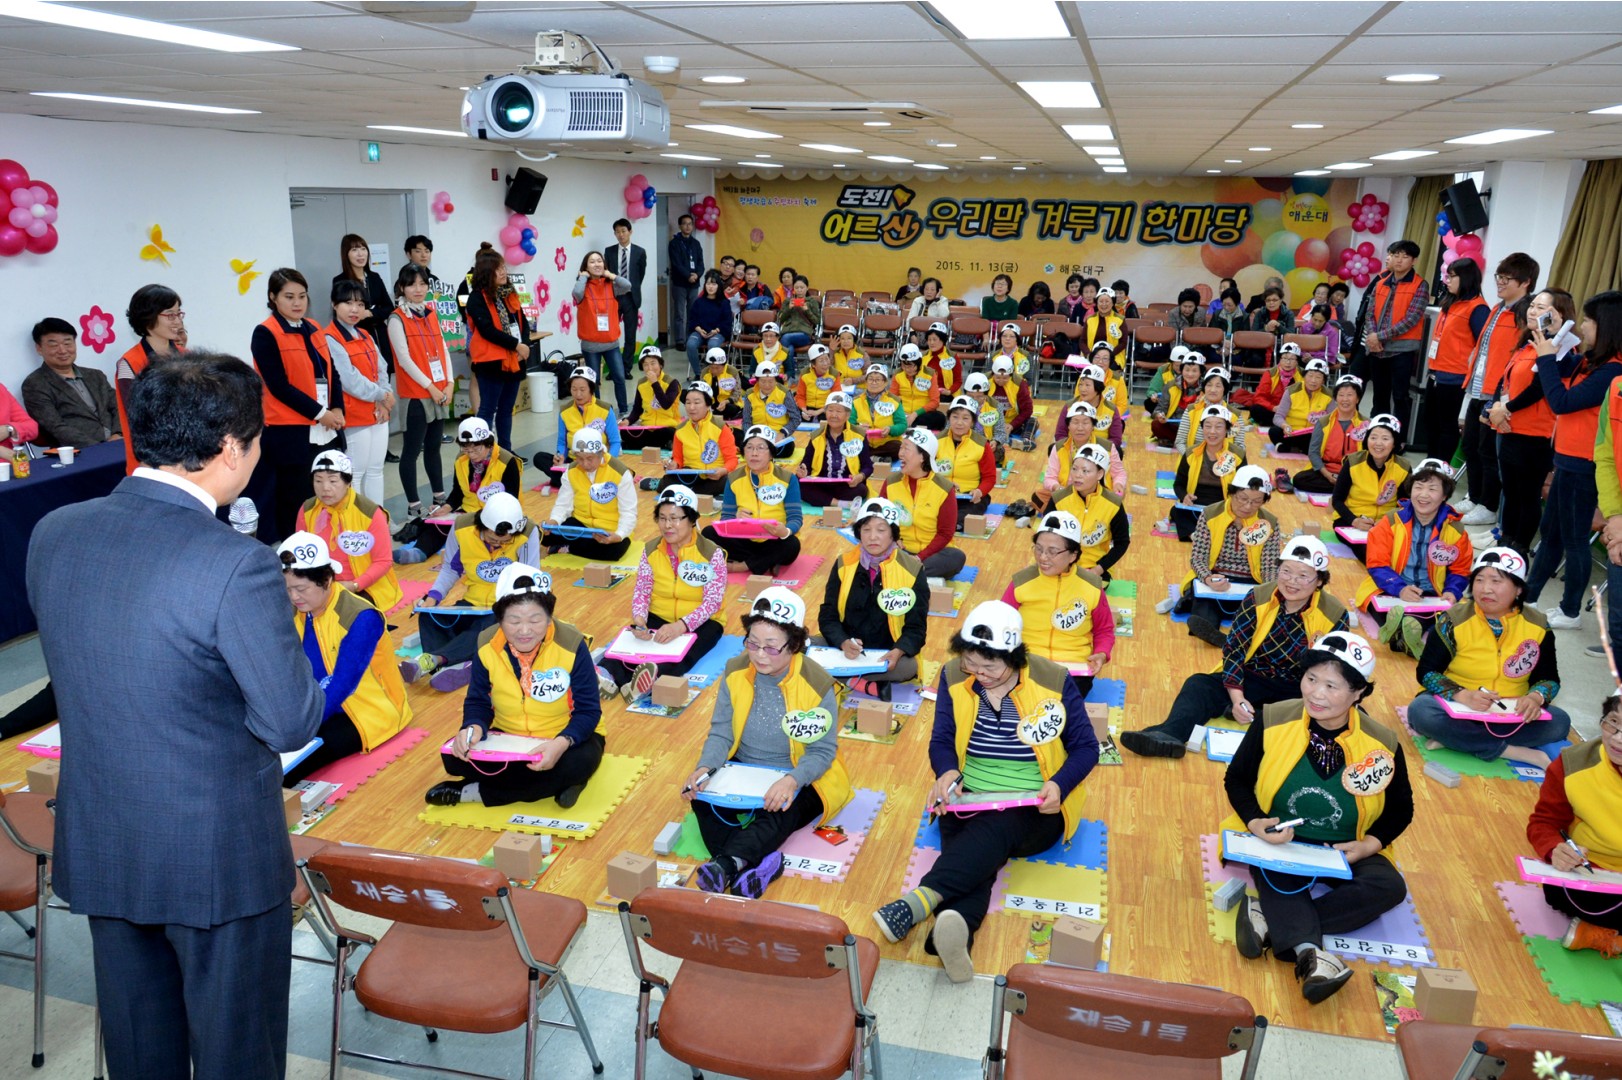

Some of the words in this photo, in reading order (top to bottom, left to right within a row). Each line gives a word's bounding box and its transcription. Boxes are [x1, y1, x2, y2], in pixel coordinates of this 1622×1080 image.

[840, 188, 893, 207] 도전!
[1288, 210, 1329, 223] 해운대
[823, 211, 921, 248] 어르신
[928, 200, 1026, 238] 우리말
[1036, 202, 1133, 240] 겨루기
[1142, 205, 1248, 244] 한마당
[936, 260, 964, 271] 2015.
[970, 261, 984, 272] 11.
[989, 261, 1019, 274] 13(금)
[1059, 263, 1105, 276] 해운대구
[765, 431, 776, 440] 31
[913, 432, 926, 444] 24
[589, 441, 601, 450] 38
[1094, 452, 1105, 462] 17
[676, 495, 688, 506] 30
[885, 509, 897, 521] 23
[1063, 519, 1077, 530] 16
[299, 547, 316, 561] 36
[1315, 556, 1324, 567] 9
[1506, 558, 1514, 570] 2
[536, 575, 550, 589] 29
[773, 602, 791, 620] 22
[1005, 631, 1017, 646] 21
[1353, 647, 1363, 661] 8
[566, 823, 585, 832] 29
[817, 862, 838, 874] 22
[351, 879, 461, 913] 재송1동
[1078, 905, 1095, 917] 21
[689, 929, 801, 963] 재송1동
[1407, 948, 1419, 960] 8
[1066, 1005, 1190, 1043] 재송1동
